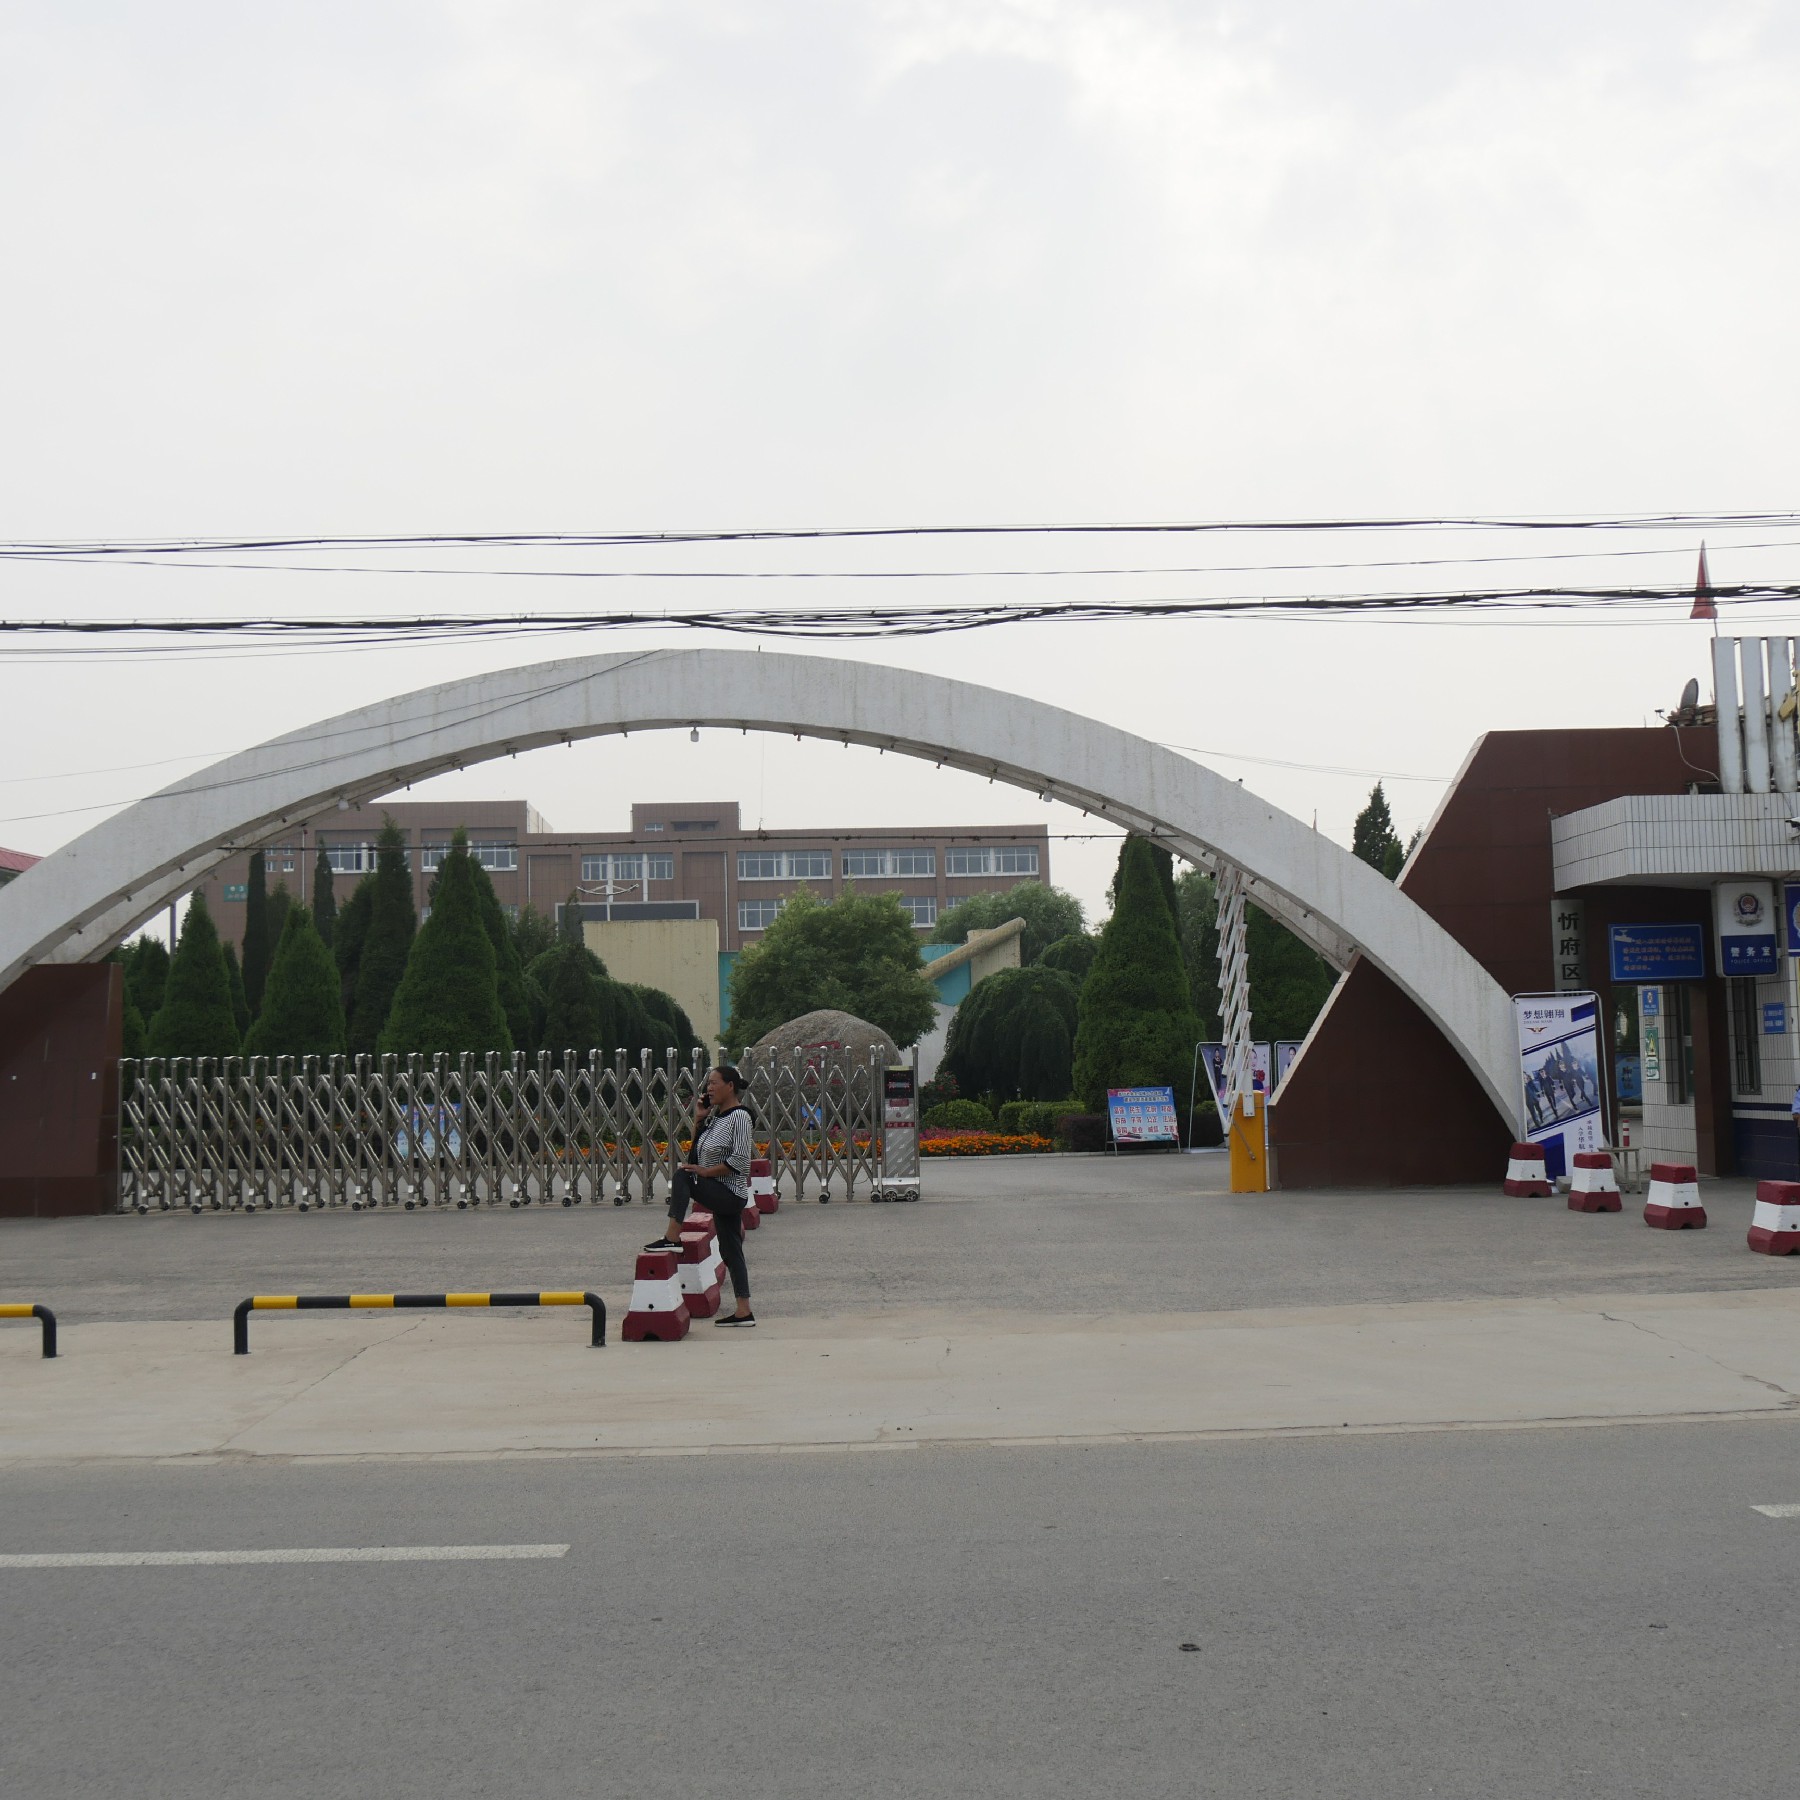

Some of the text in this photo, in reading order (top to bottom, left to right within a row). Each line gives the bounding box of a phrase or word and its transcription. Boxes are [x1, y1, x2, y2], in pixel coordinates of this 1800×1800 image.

[1557, 912, 1582, 996] 忻府区
[1731, 946, 1771, 957] 警务室
